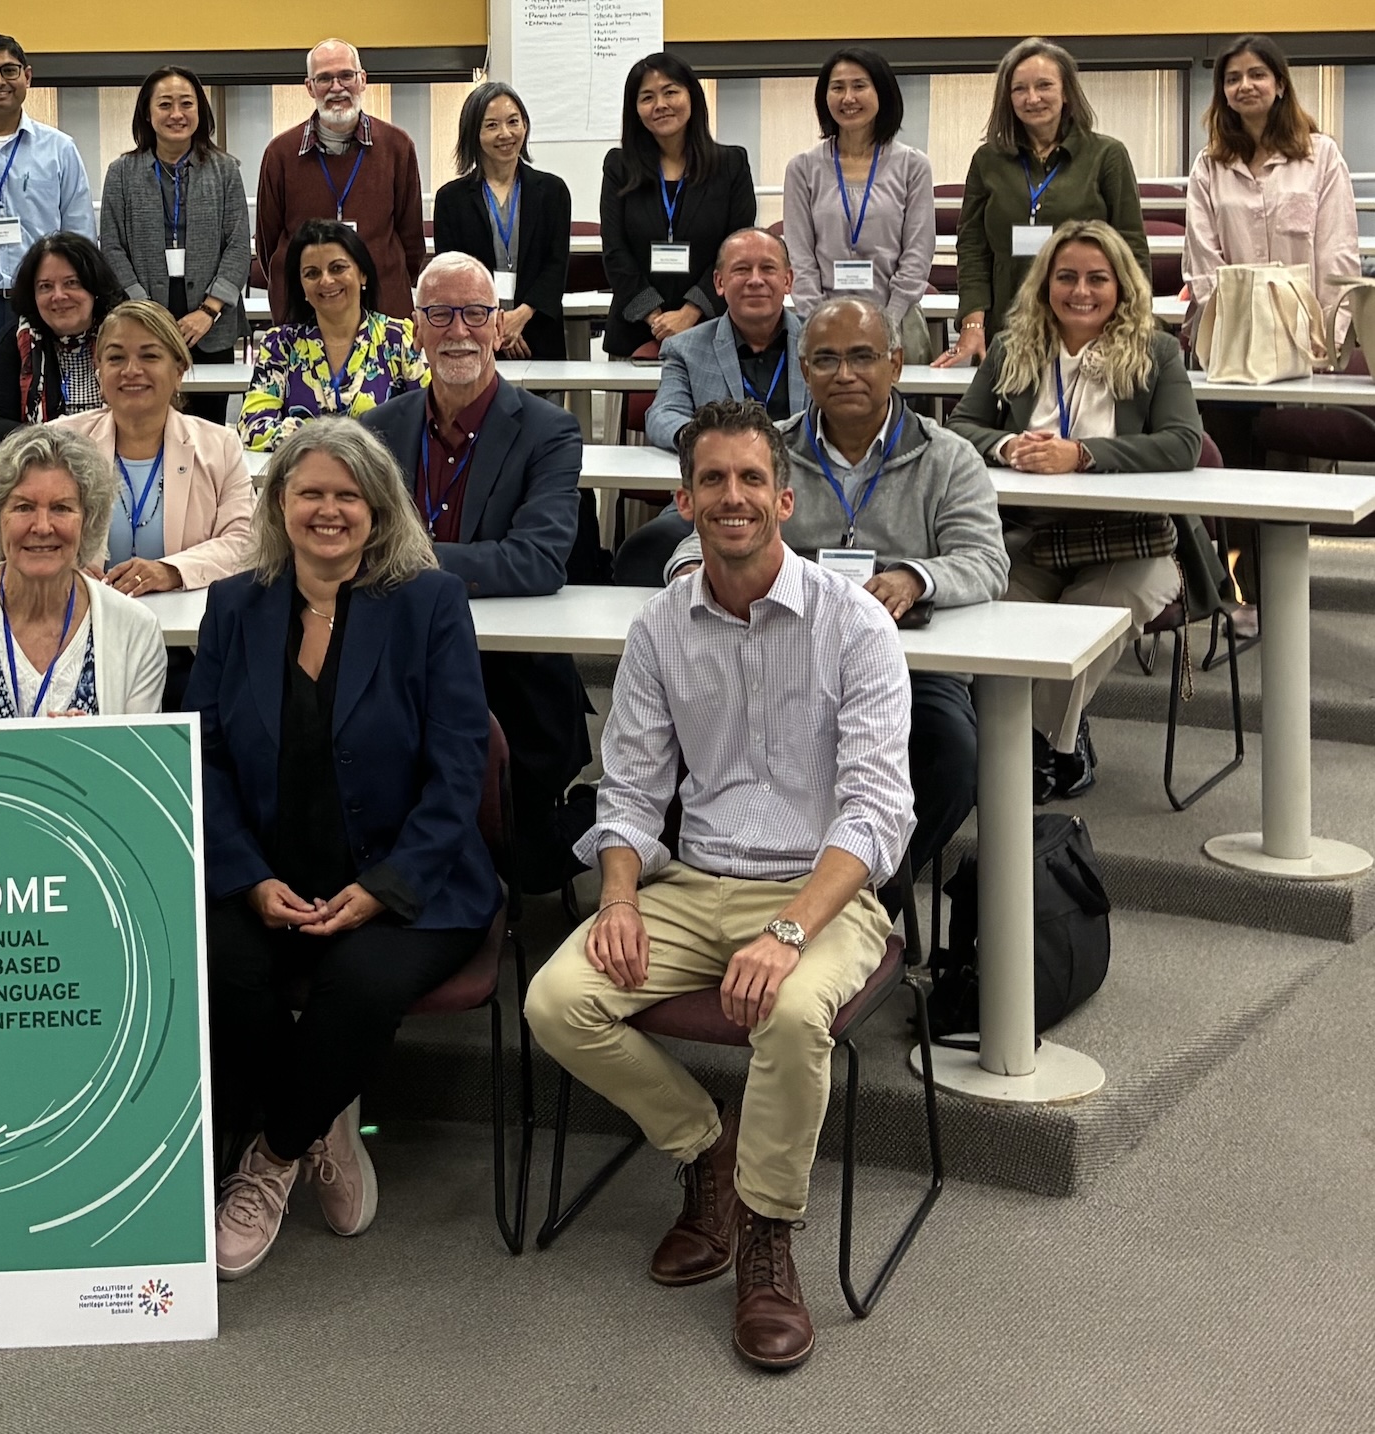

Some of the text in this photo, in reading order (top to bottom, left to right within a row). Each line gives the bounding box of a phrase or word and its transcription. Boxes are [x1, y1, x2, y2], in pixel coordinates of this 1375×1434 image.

[80, 1291, 133, 1300] Community-Based
[79, 1300, 133, 1309] Heritage Language
